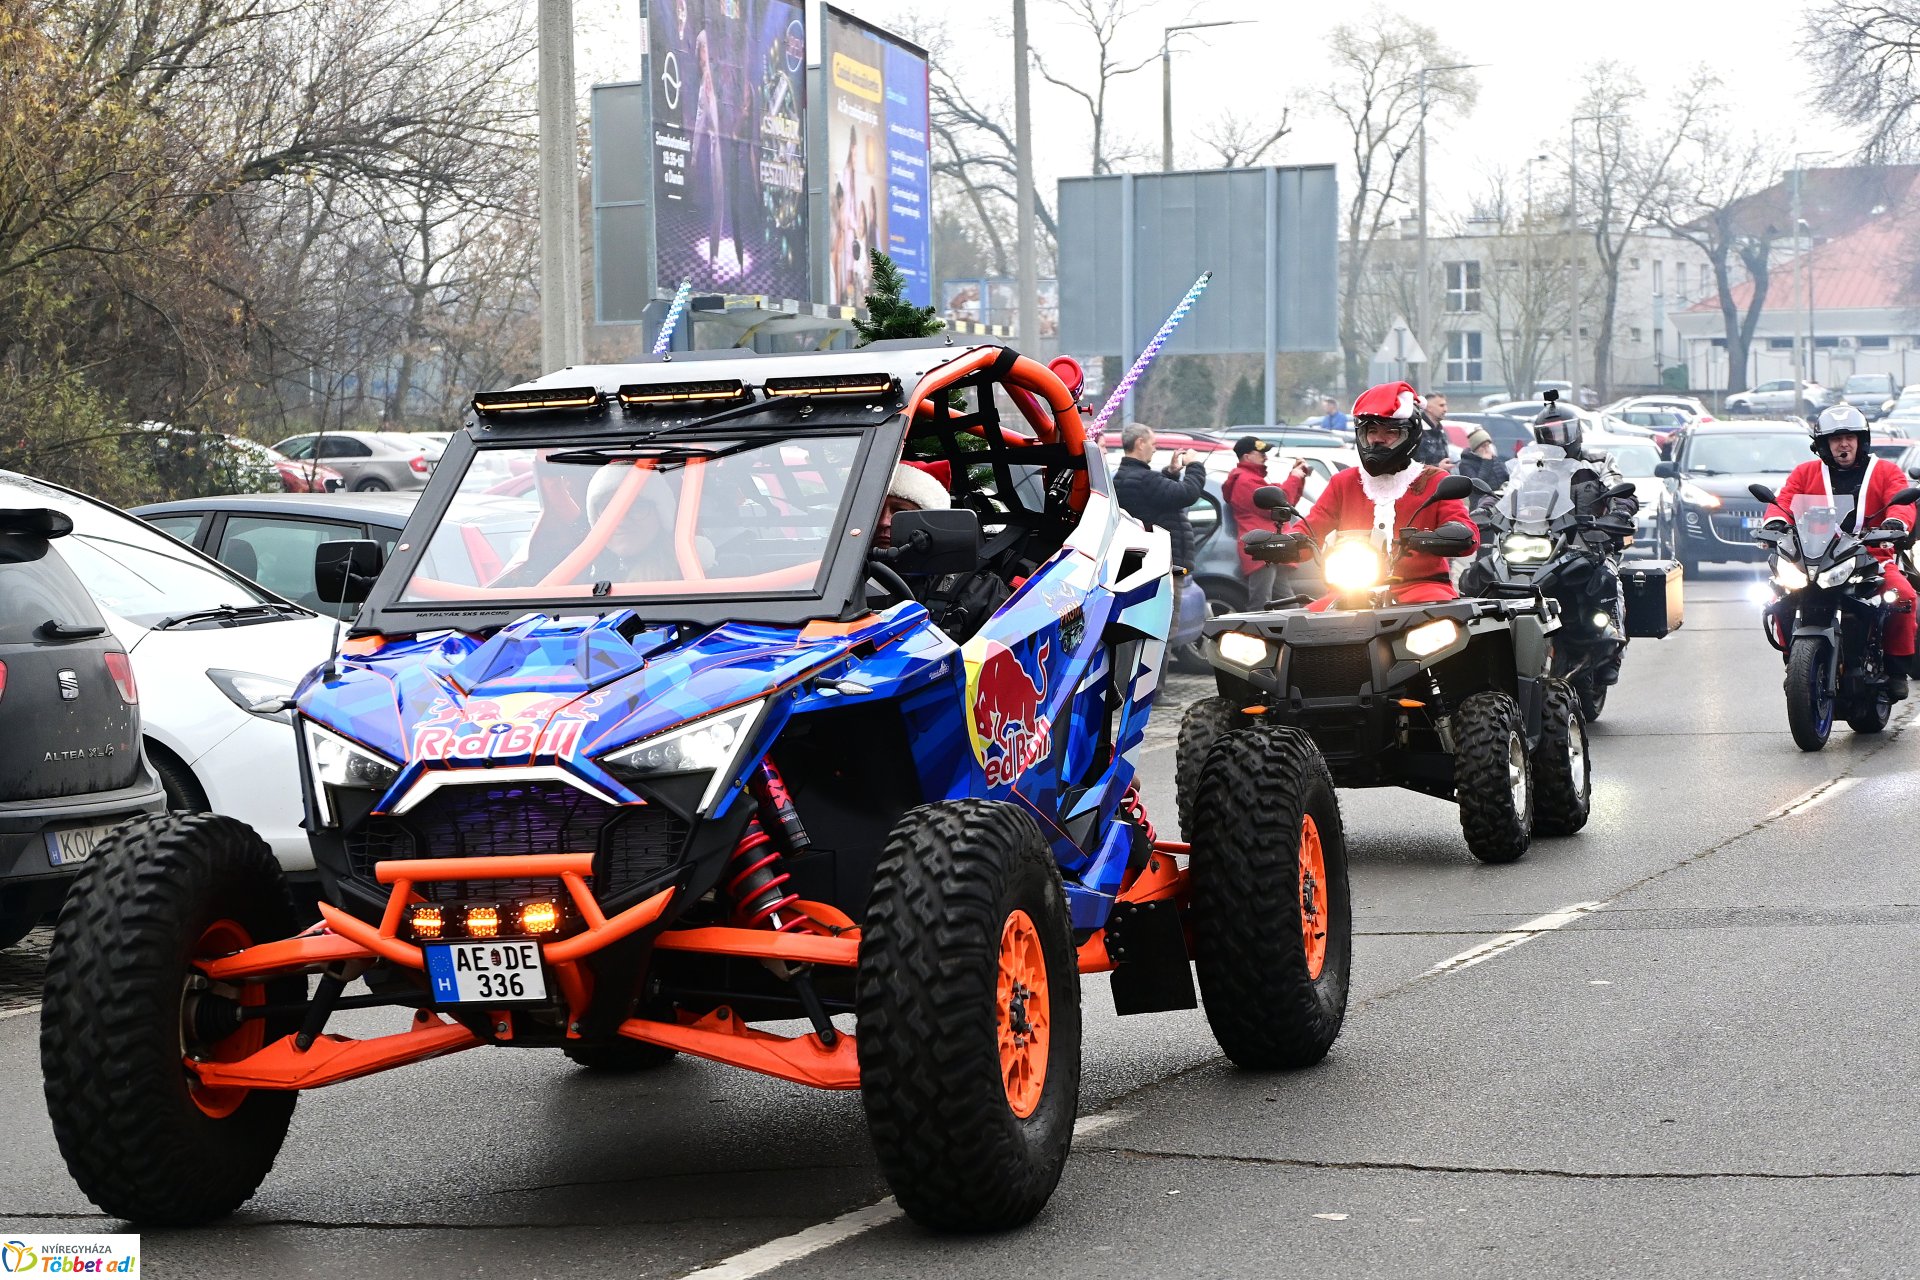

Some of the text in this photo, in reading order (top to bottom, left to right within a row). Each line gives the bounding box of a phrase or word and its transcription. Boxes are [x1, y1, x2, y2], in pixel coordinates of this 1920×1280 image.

[43, 748, 86, 762] ALTEA
[413, 719, 584, 762] Red Bull
[980, 729, 1015, 788] ed
[60, 828, 108, 860] KOK
[457, 945, 538, 971] AE DE
[438, 972, 525, 998] H 336
